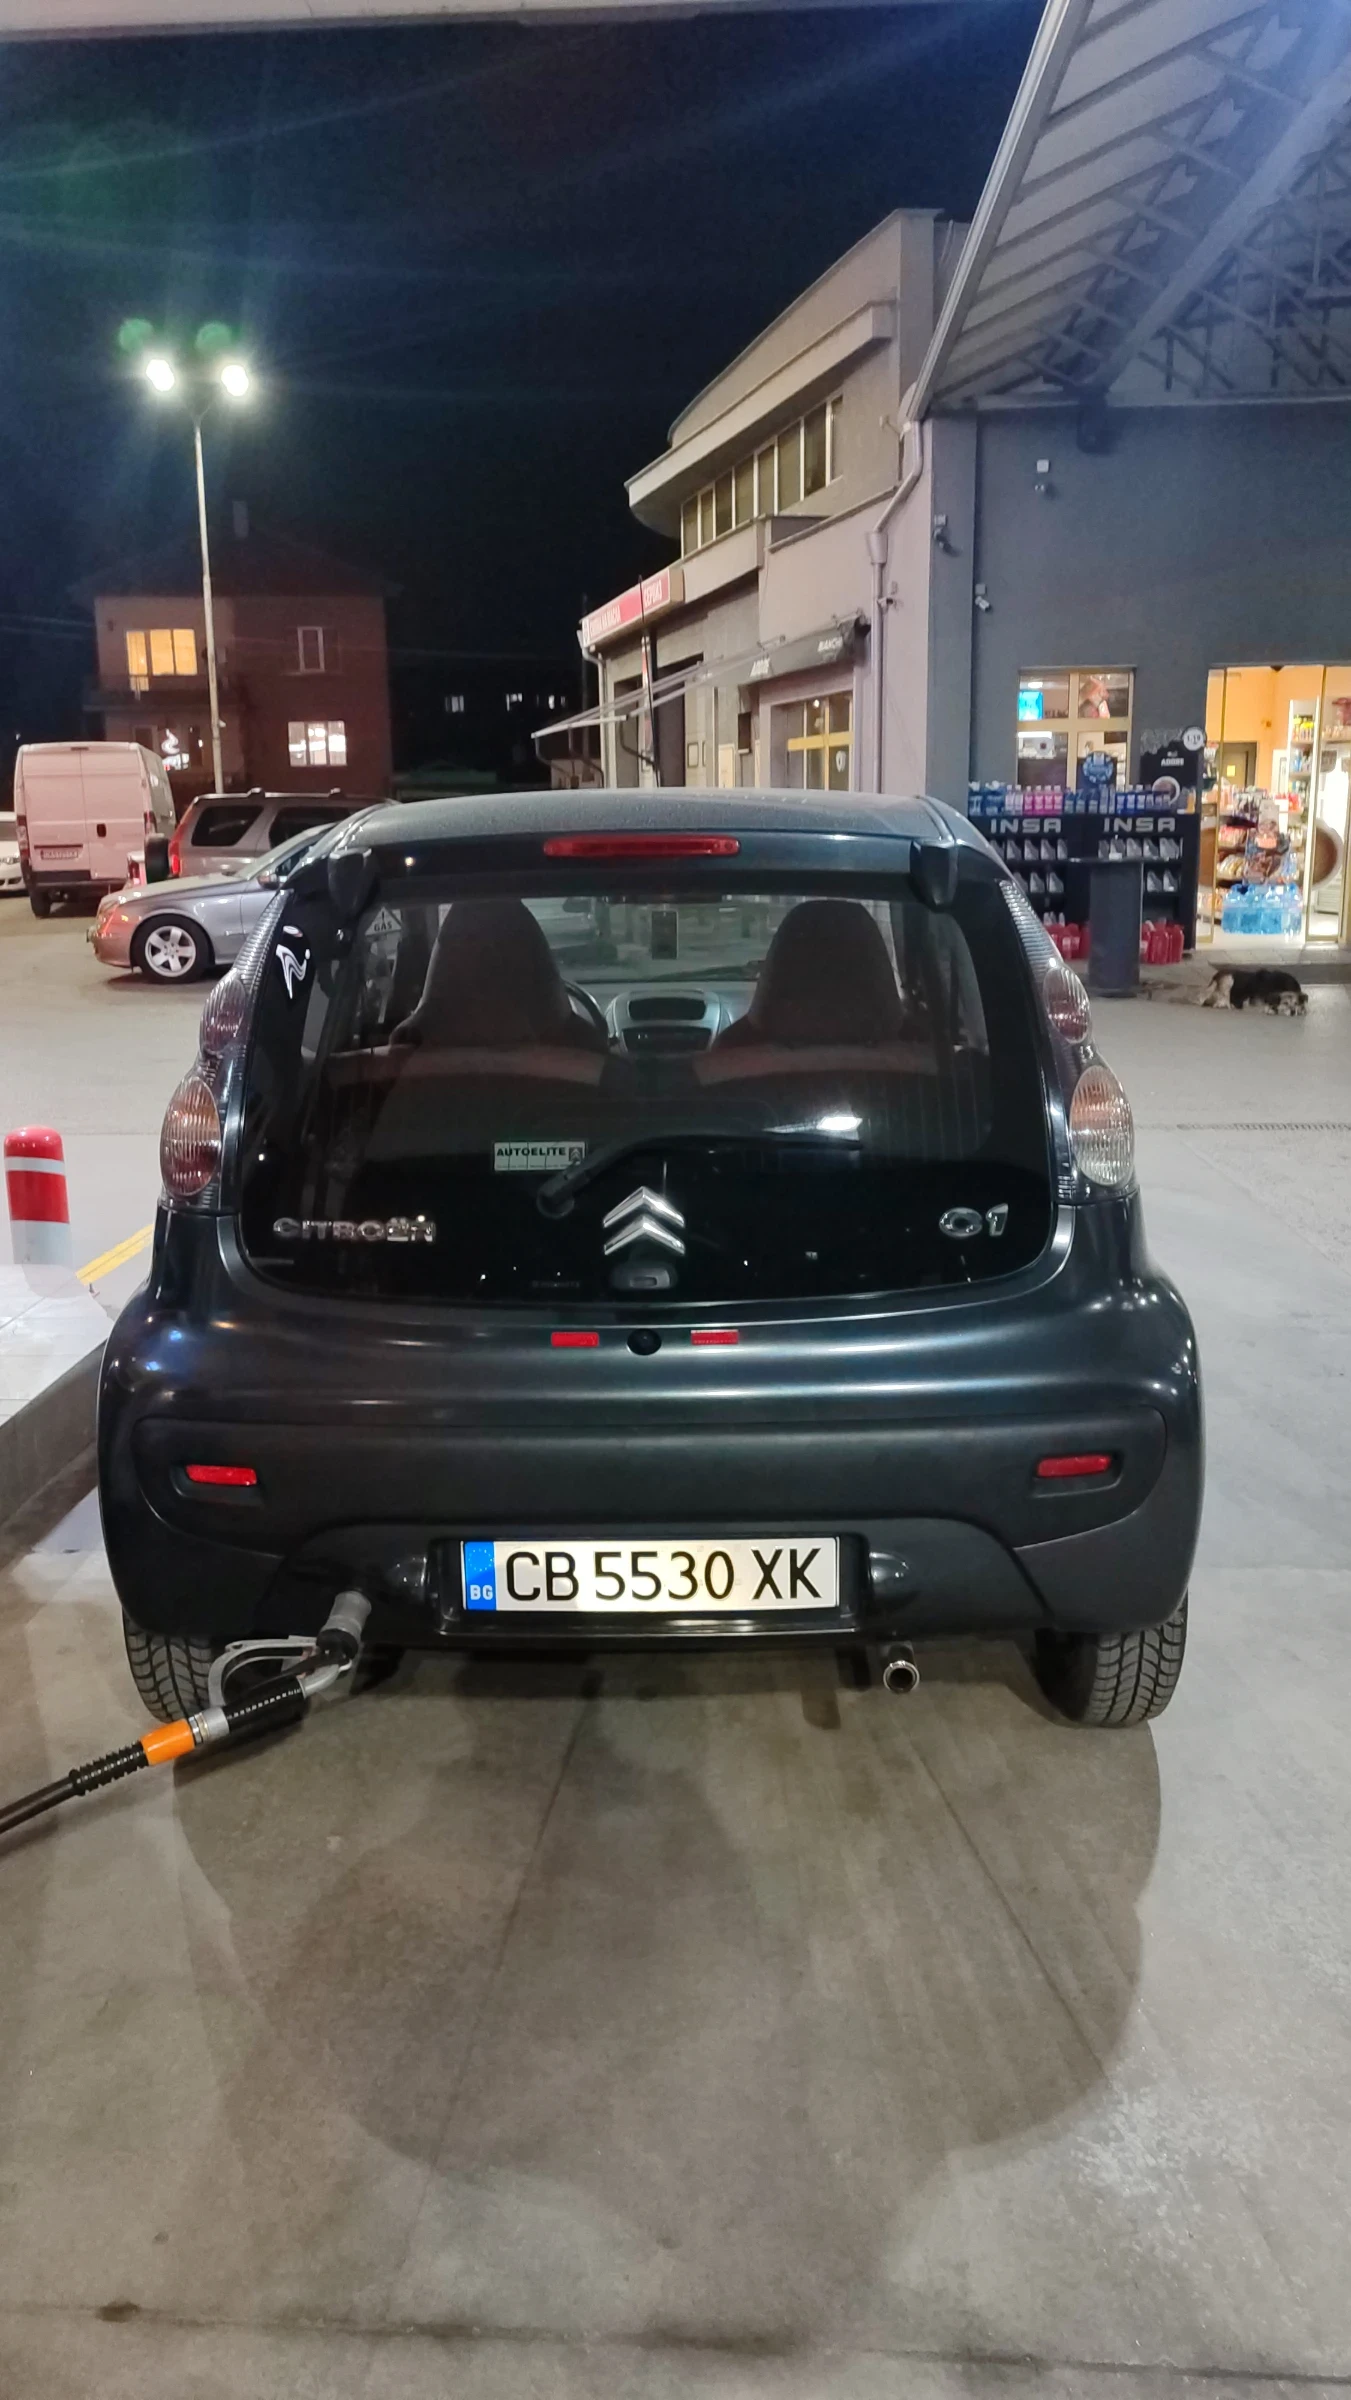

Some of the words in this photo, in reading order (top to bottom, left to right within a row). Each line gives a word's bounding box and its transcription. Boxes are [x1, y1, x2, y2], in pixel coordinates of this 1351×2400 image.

[990, 819, 1062, 834] INSA
[1104, 818, 1176, 833] INSA
[374, 919, 392, 932] GAS
[496, 1147, 566, 1157] AUTOELITE
[506, 1551, 579, 1602] CB
[594, 1550, 735, 1602] 5530
[750, 1548, 822, 1601] XK
[470, 1584, 494, 1601] BG
